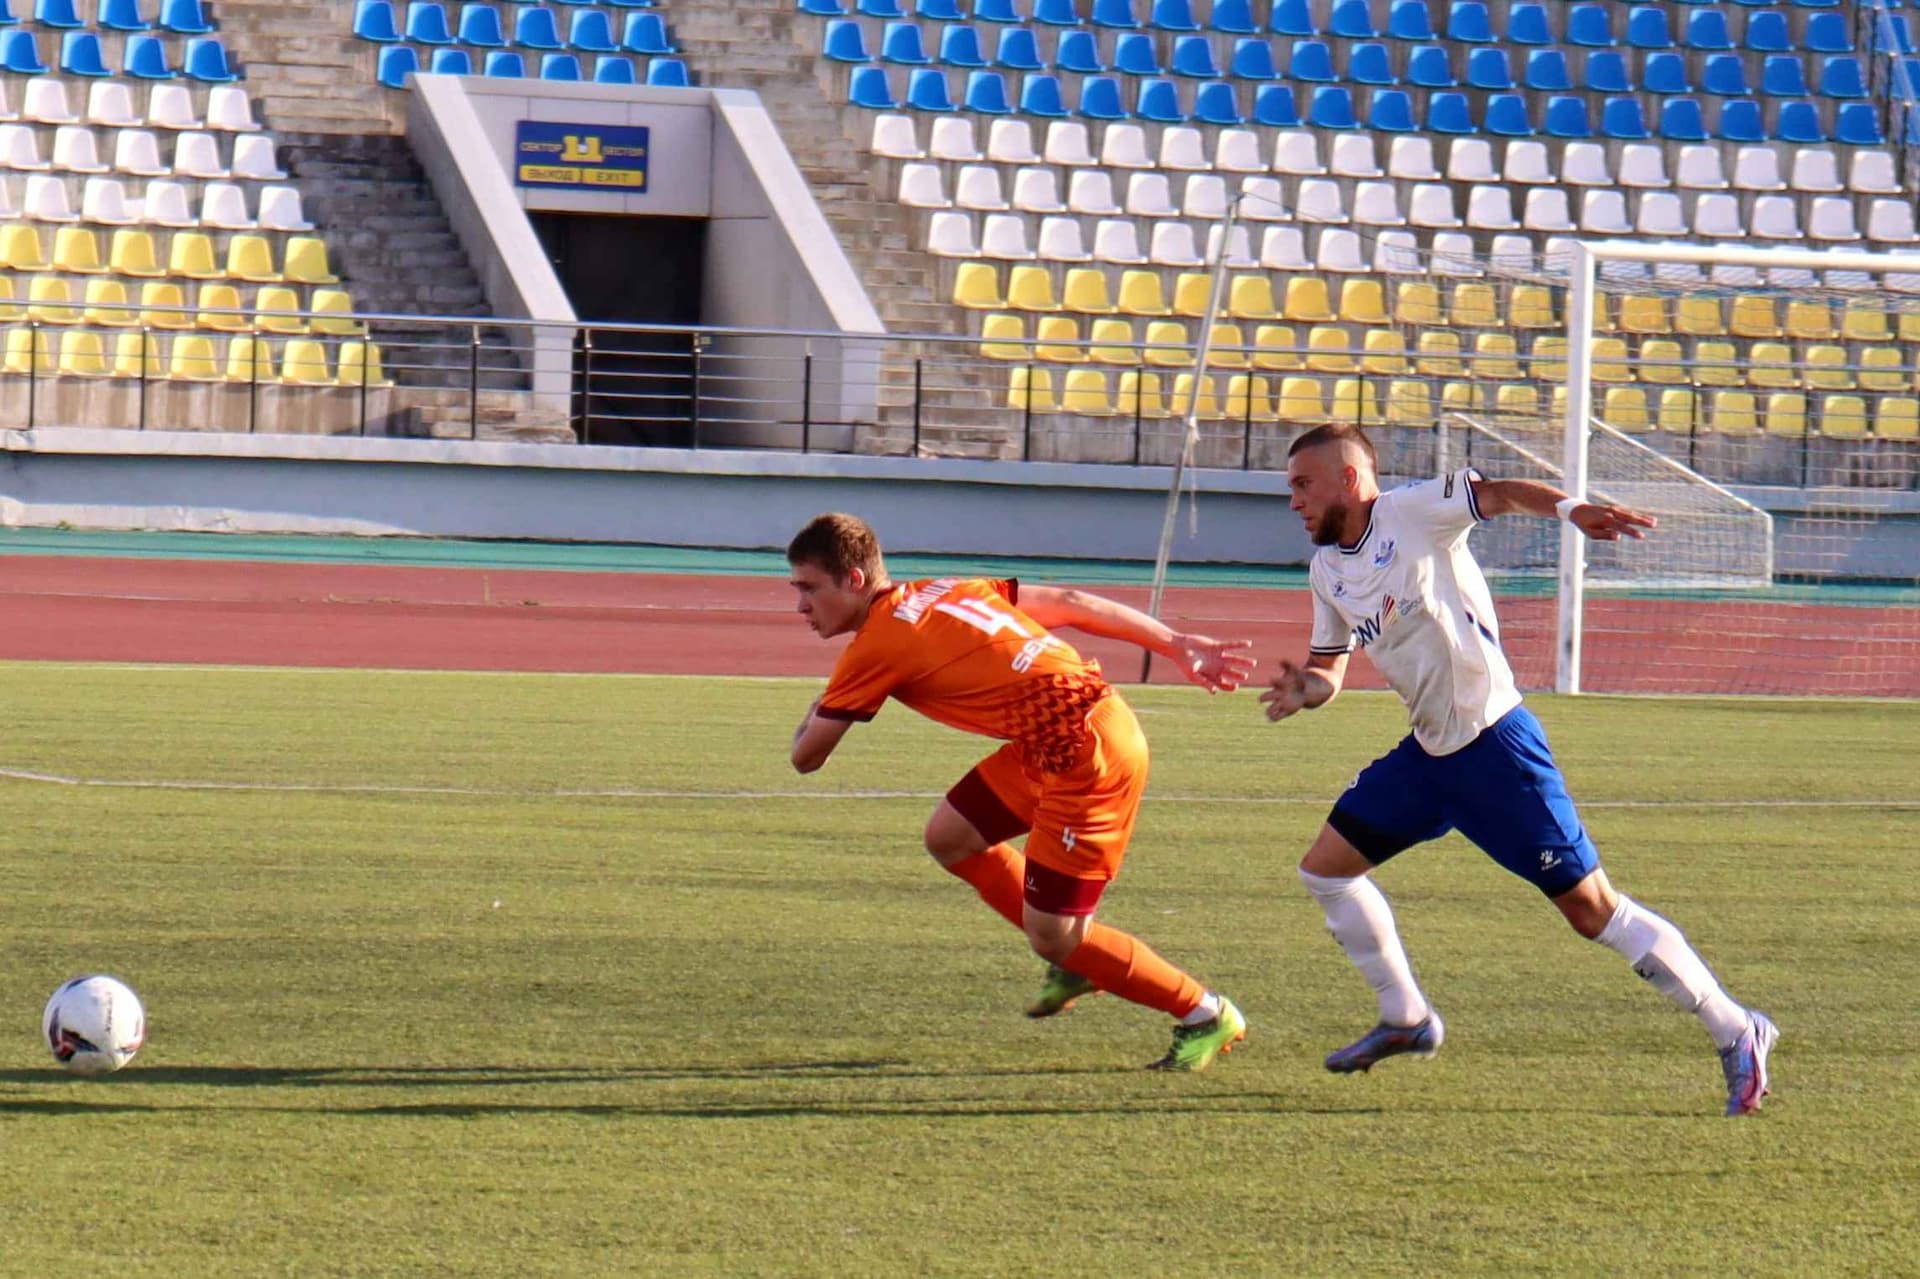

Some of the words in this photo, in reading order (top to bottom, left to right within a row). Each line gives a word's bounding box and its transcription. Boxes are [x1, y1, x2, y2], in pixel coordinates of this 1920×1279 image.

[561, 135, 603, 162] 11
[597, 171, 628, 183] EXIT
[1062, 826, 1076, 852] 4
